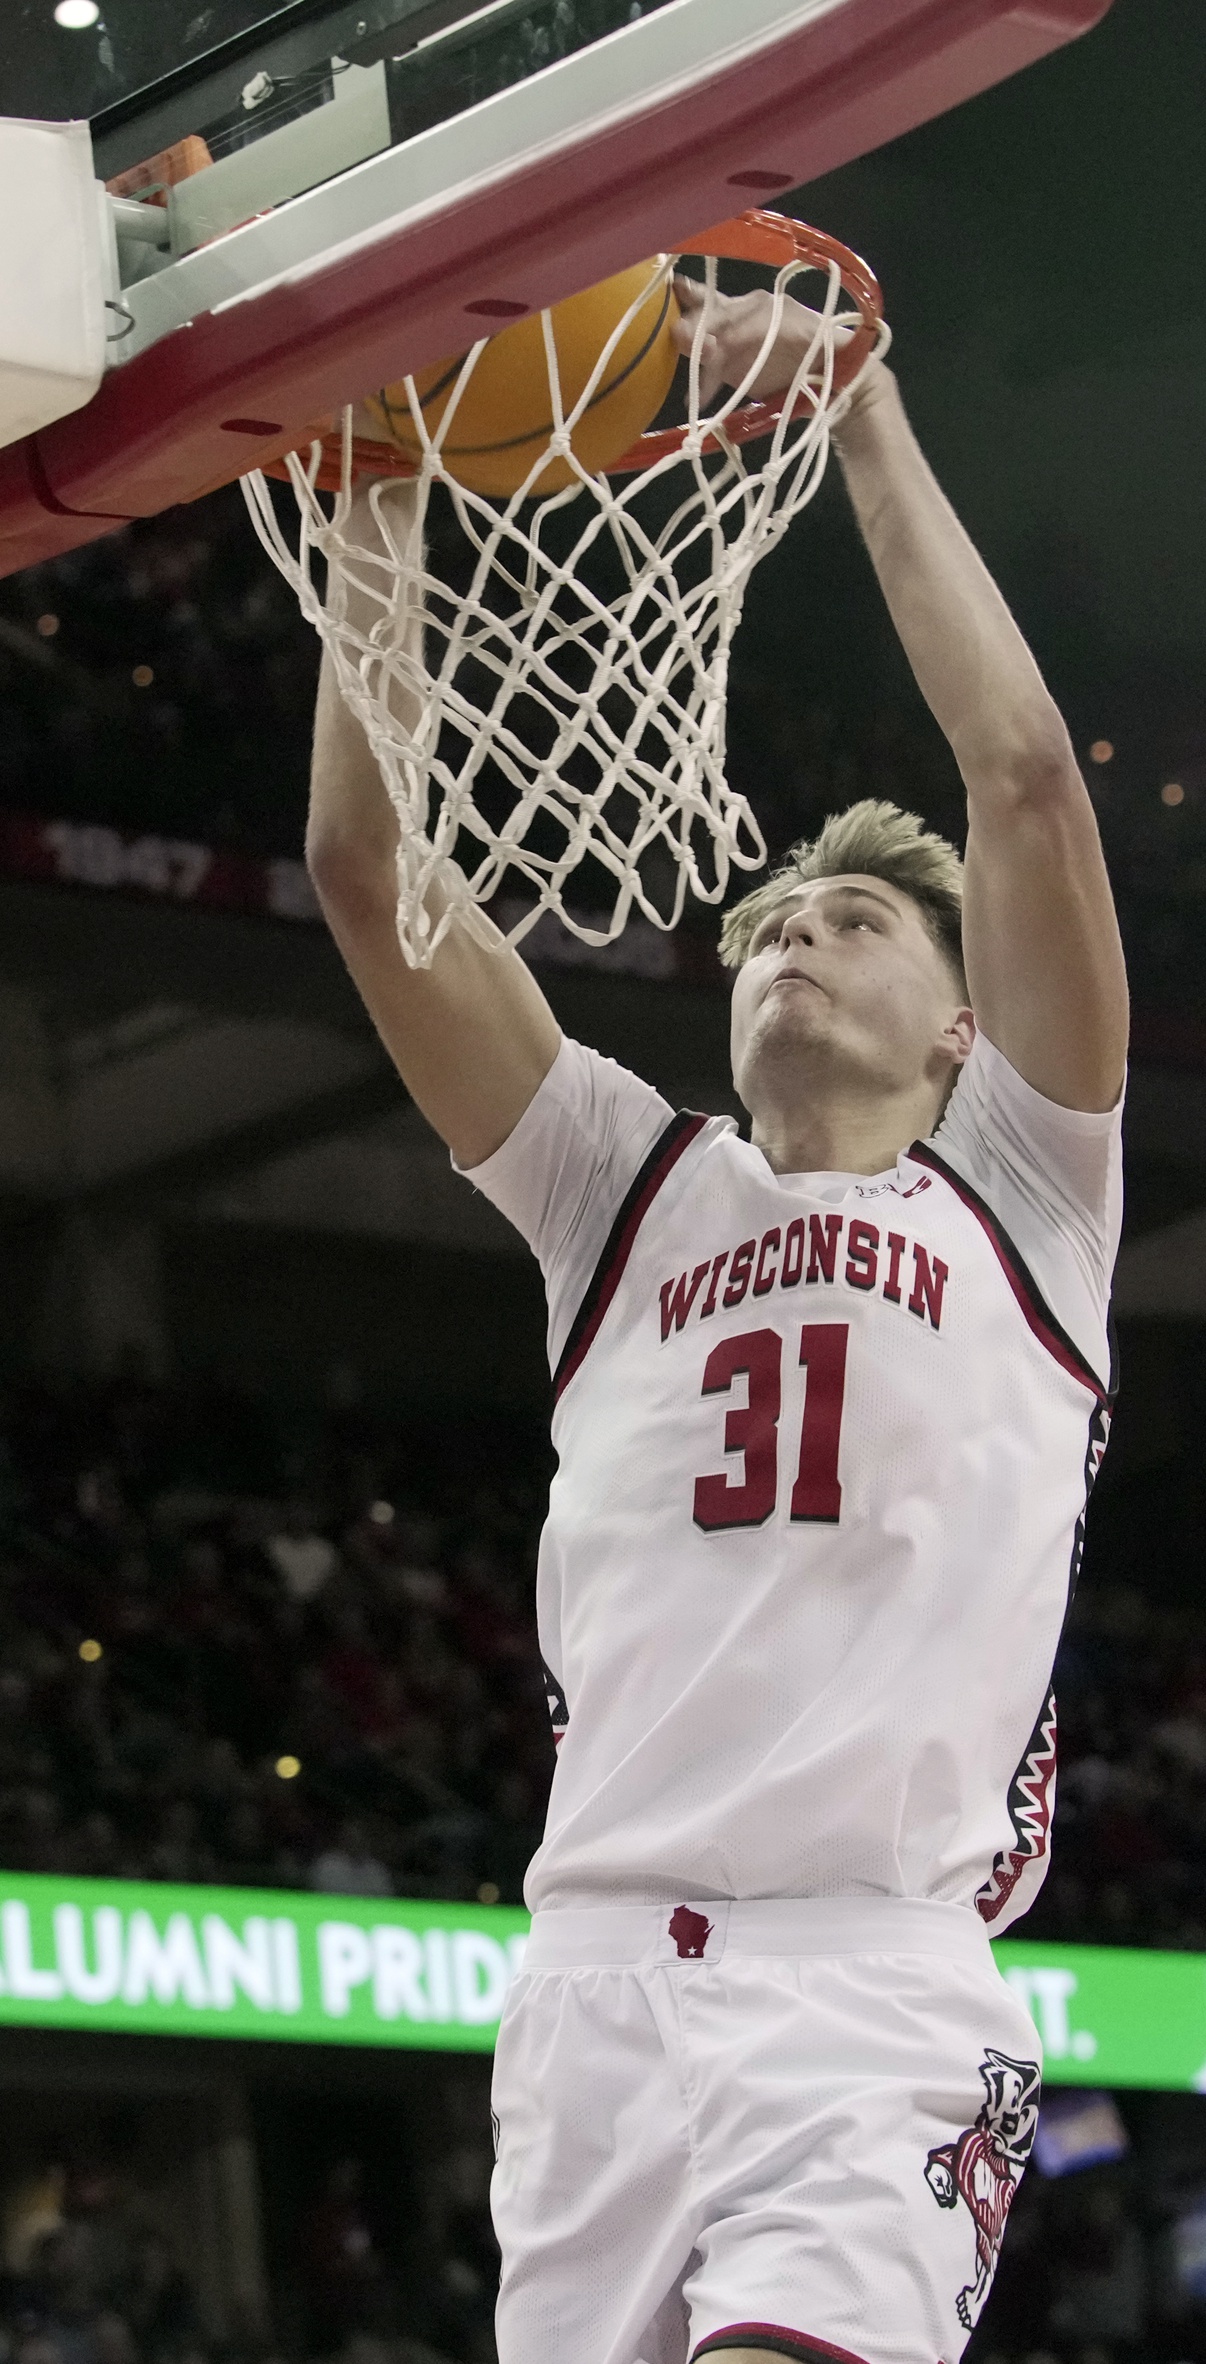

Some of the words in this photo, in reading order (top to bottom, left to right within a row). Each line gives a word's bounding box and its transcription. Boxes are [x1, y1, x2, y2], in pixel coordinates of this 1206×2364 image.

[658, 1213, 949, 1345] WISCONSIN
[692, 1323, 850, 1532] 31
[0, 1899, 303, 2017] LUMNI
